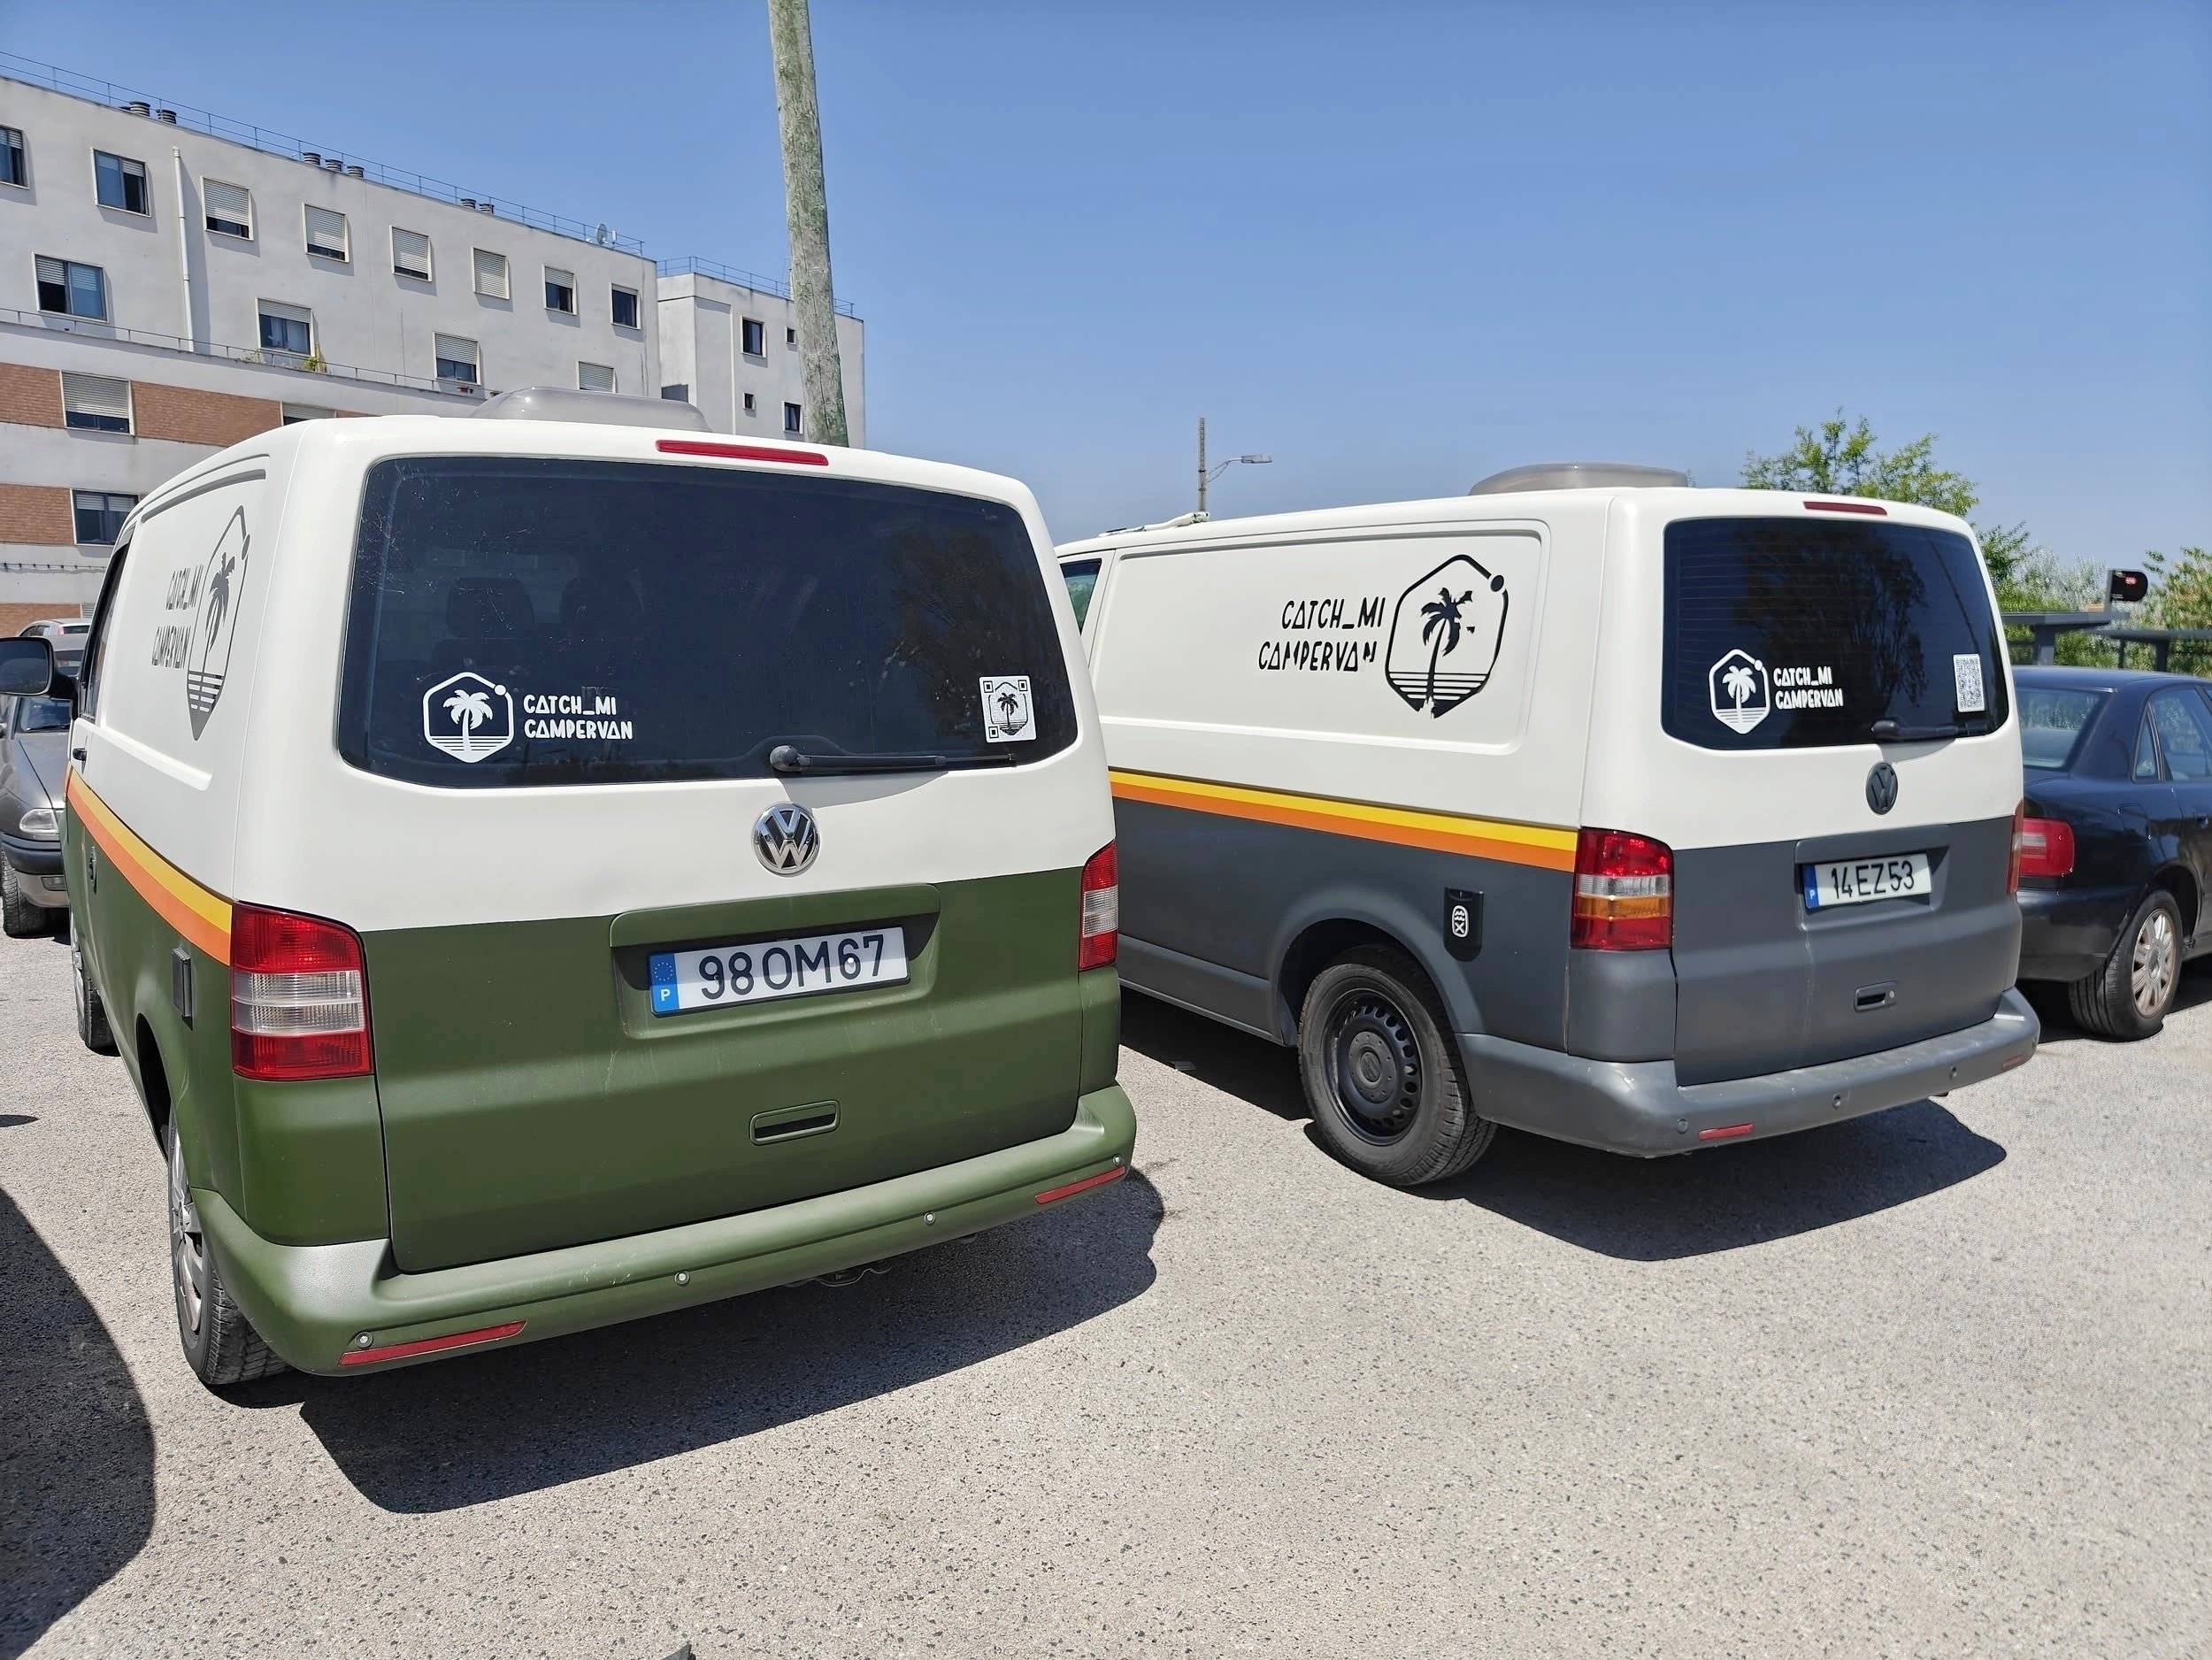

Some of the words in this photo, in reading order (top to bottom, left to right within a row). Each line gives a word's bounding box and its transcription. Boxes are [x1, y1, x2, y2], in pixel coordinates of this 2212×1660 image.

[1281, 596, 1386, 629] CATCH_MI
[1773, 666, 1833, 686] CATCH_MI
[523, 695, 617, 715] CATCH_MI
[1775, 688, 1844, 709] CAMPERVAN
[524, 719, 633, 739] CAMPERVAN
[660, 988, 671, 1002] P
